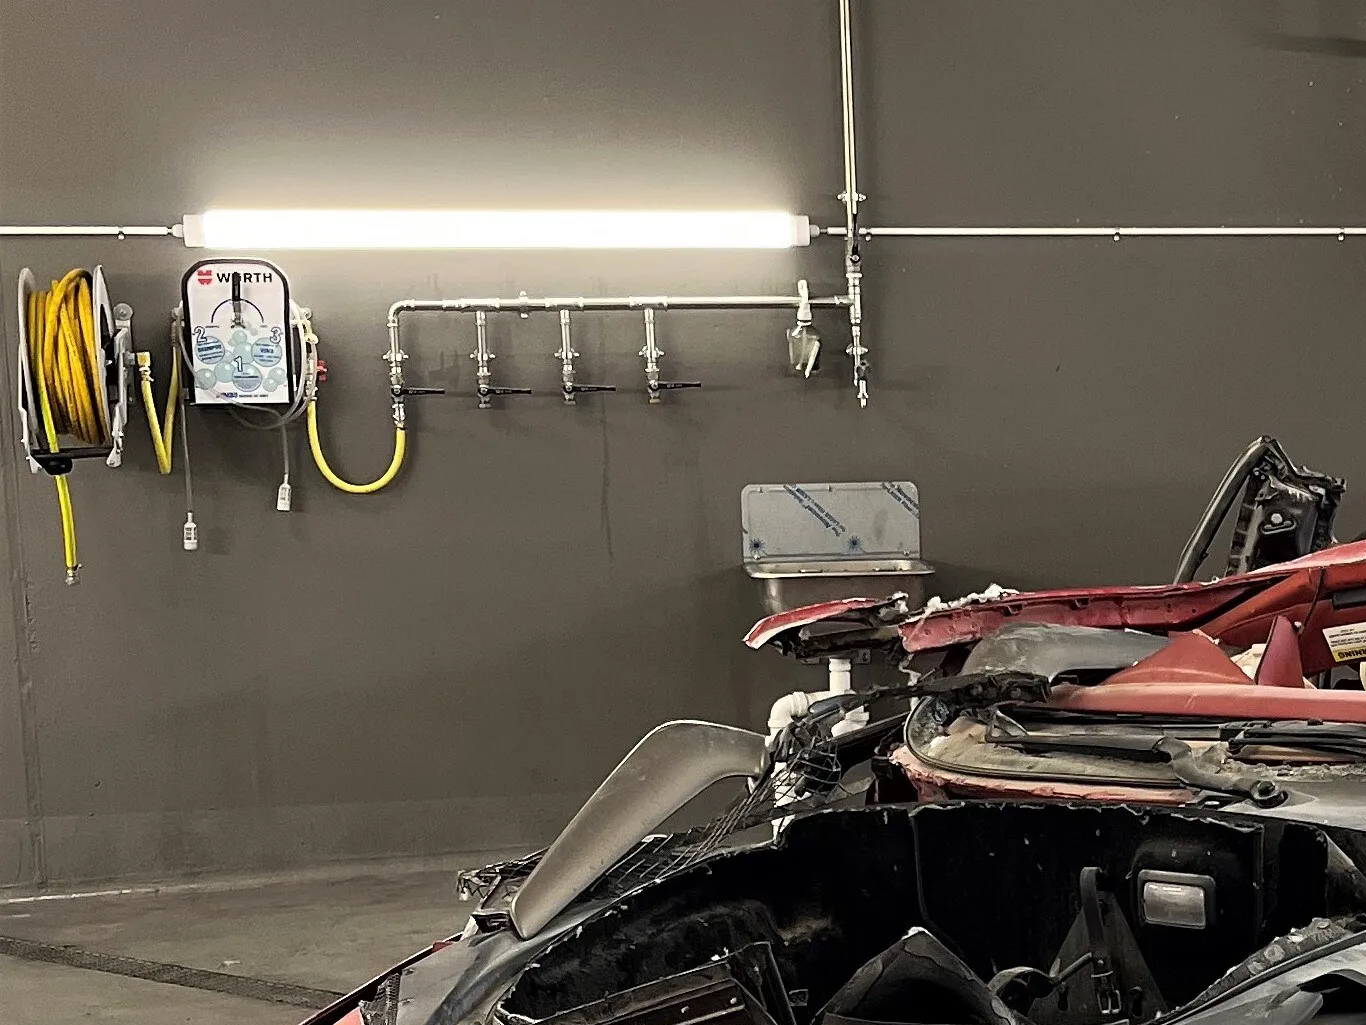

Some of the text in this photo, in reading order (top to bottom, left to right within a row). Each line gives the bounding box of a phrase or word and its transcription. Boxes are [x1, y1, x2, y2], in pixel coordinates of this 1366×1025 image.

[216, 272, 273, 284] WRTH
[194, 326, 208, 343] 2
[269, 326, 282, 344] 3
[233, 355, 243, 372] 1
